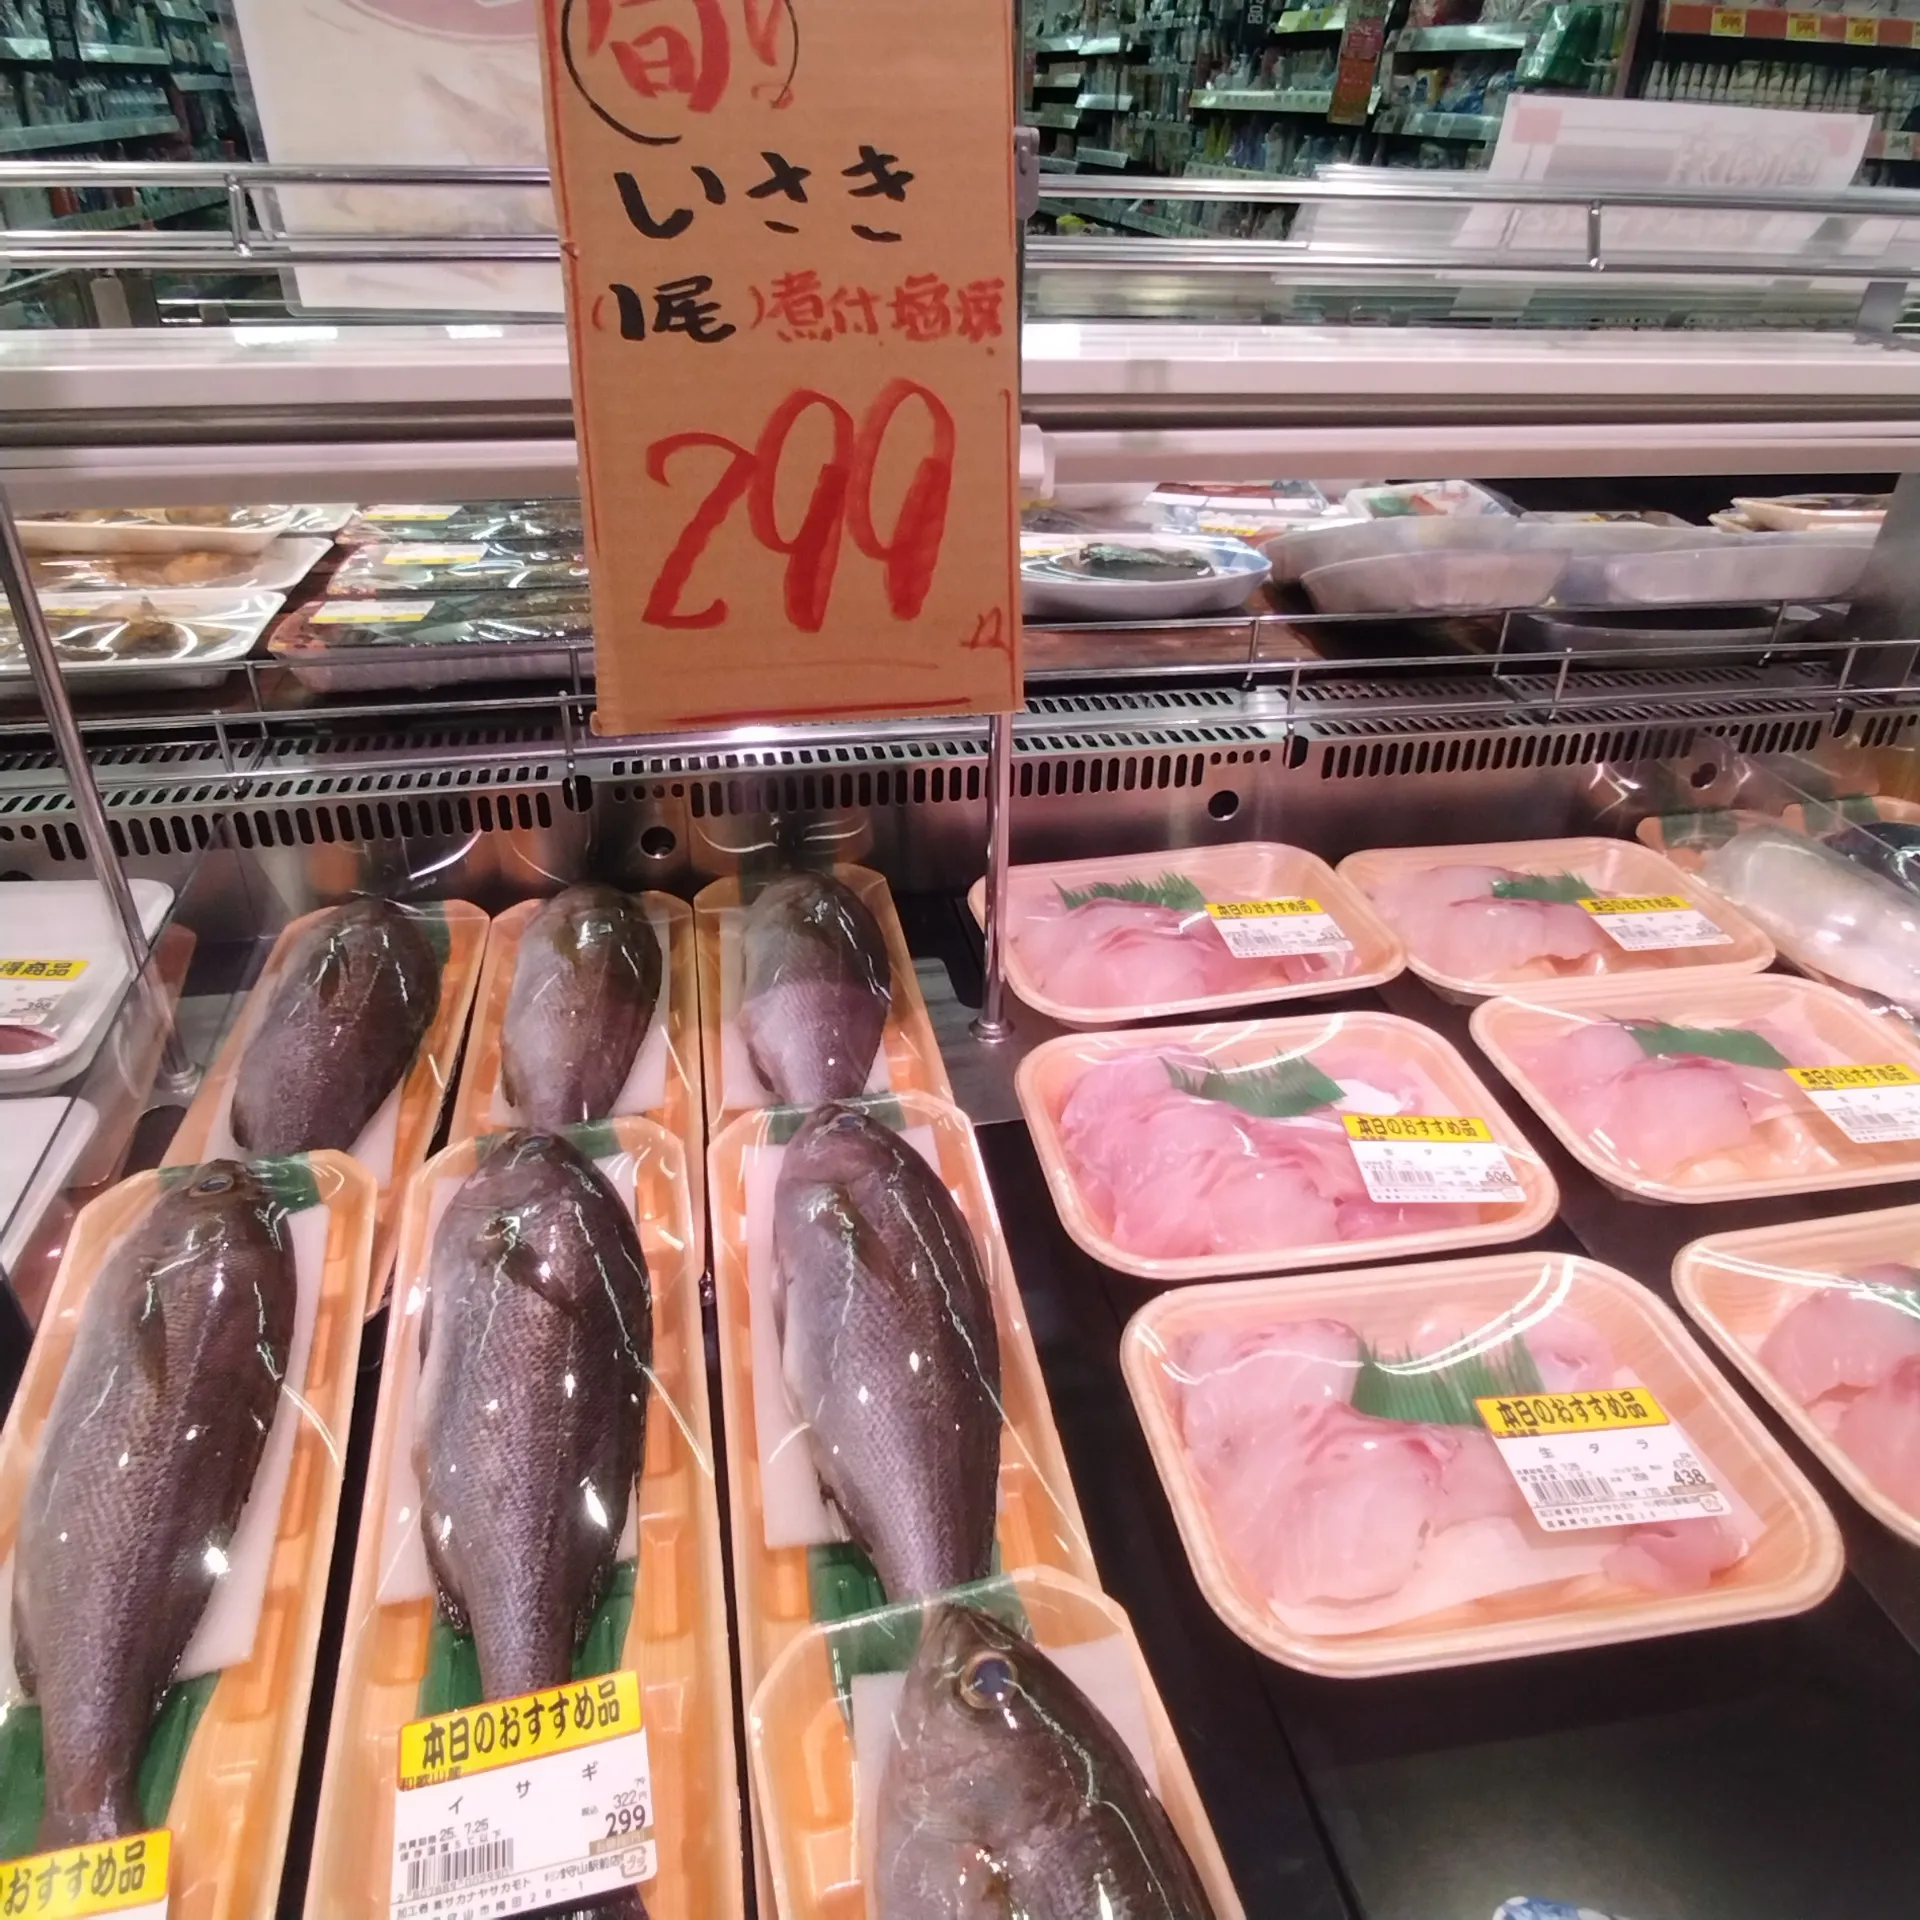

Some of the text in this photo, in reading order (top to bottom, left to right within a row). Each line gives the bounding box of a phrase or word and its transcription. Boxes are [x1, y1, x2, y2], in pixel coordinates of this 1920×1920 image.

[614, 145, 915, 242] いさき
[641, 376, 955, 633] 299
[1216, 899, 1313, 916] 本日のおすすめ品
[1356, 1116, 1479, 1138] 本日のおすすめ品
[1496, 1387, 1649, 1429] 本日のおすすめ品
[1673, 1467, 1707, 1487] 438
[421, 1678, 621, 1770] 本日のおすすめ品
[605, 1803, 646, 1838] 299
[0, 1839, 146, 1917] おすすめ品
